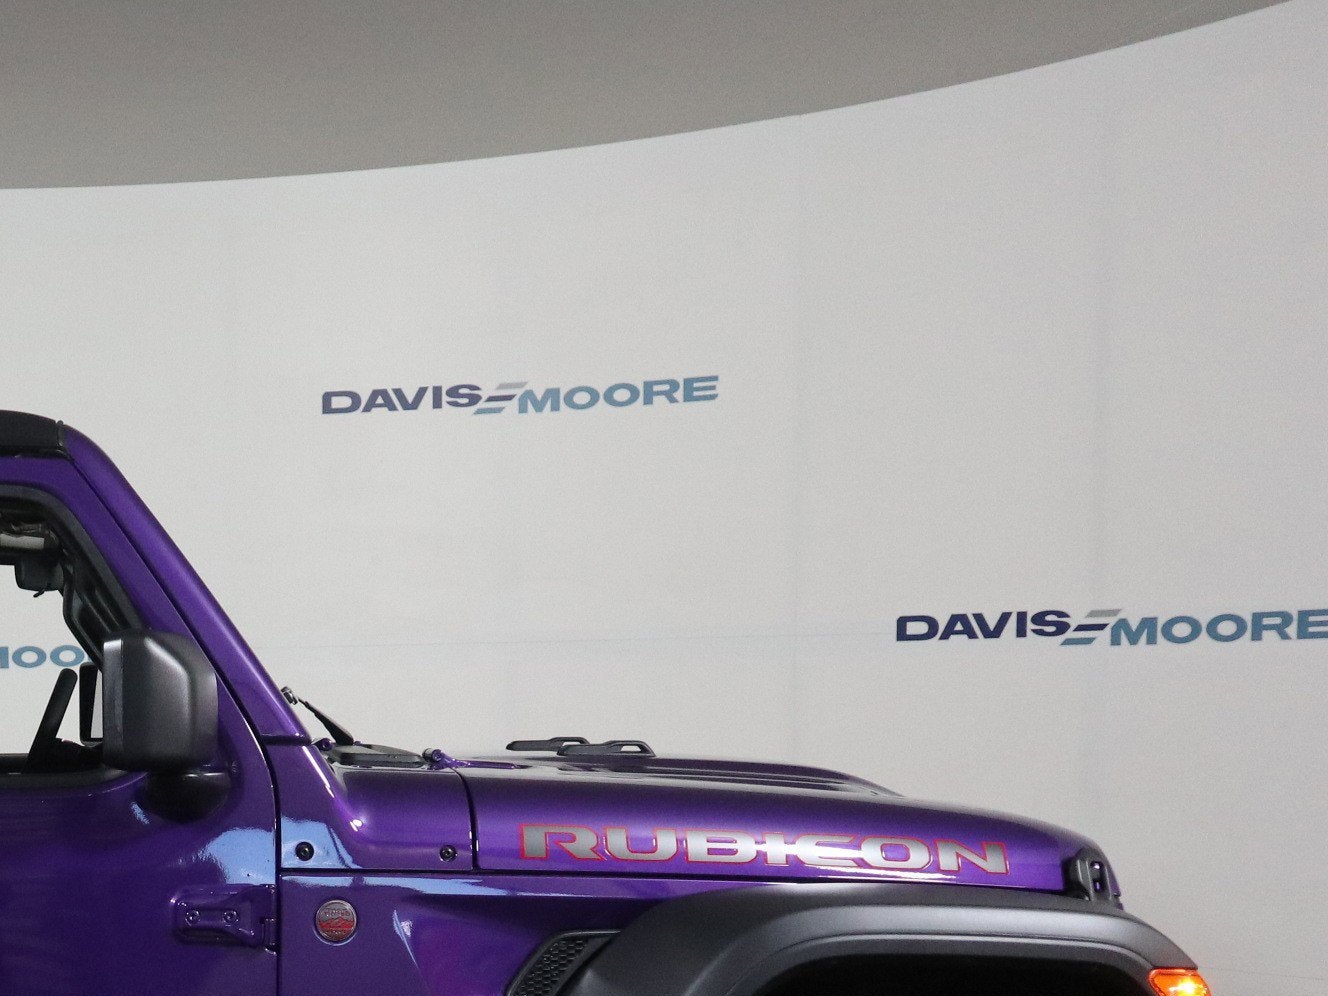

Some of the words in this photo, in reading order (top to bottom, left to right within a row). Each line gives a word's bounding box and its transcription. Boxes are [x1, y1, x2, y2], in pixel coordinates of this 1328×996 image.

[321, 383, 482, 415] DAVIS
[518, 375, 719, 414] MOORE
[896, 609, 1071, 642] DAVIS
[1110, 608, 1328, 647] MOORE
[518, 823, 1009, 875] RUBICON
